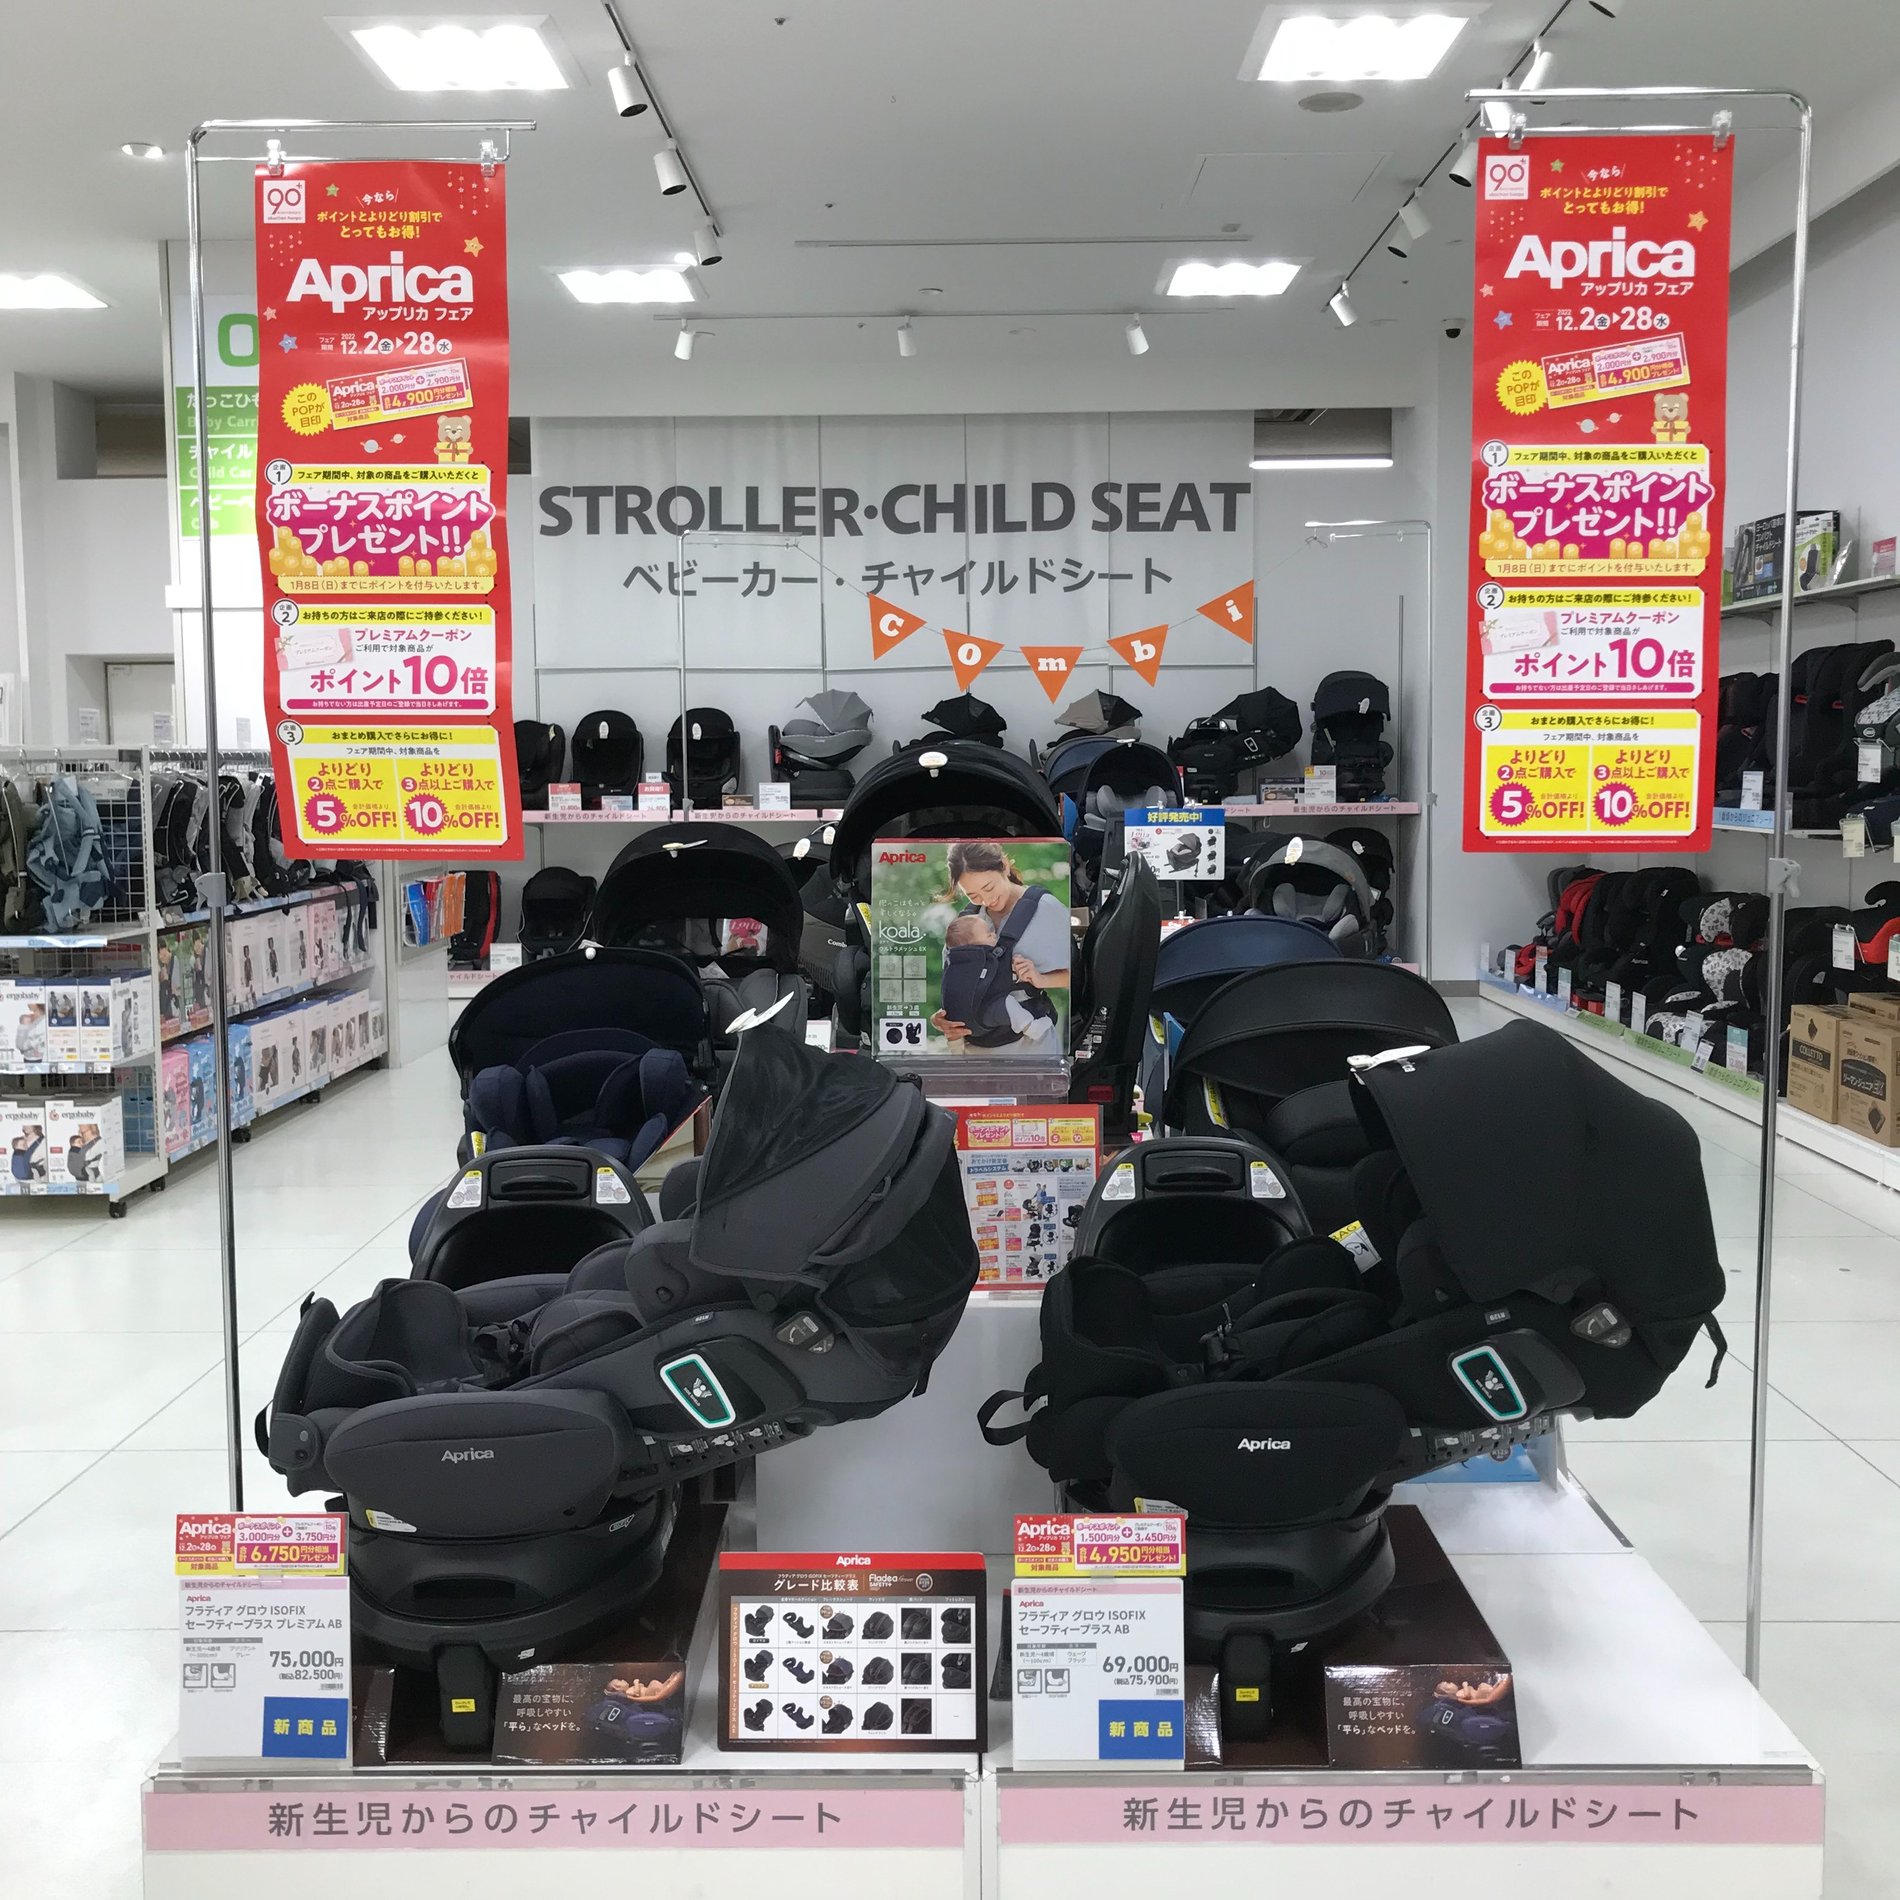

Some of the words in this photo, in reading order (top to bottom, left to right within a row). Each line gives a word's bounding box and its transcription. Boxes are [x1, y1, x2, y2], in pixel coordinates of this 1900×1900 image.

[1587, 166, 1621, 180] 今なら
[362, 191, 395, 204] 今なら
[1540, 187, 1668, 198] ポイントとよりどり割引で
[1563, 201, 1645, 214] とってもお得!
[317, 211, 442, 222] ポイントとよりどり割引で
[339, 225, 420, 239] とってもお得!
[1504, 227, 1695, 289] Aprica
[286, 251, 473, 313] Aprica
[1581, 283, 1647, 296] アップリカ
[1654, 283, 1693, 295] フェア
[362, 307, 428, 321] アップリカ
[435, 307, 473, 321] フェア
[1548, 358, 1590, 374] Aprica
[1512, 370, 1532, 381] この
[333, 382, 375, 397] Aprica
[1507, 380, 1540, 393] POPが
[297, 393, 317, 403] この
[1515, 395, 1536, 407] 目印
[292, 403, 325, 416] POPが
[301, 417, 321, 428] 目印
[1492, 453, 1497, 463] 1
[1514, 452, 1697, 460] フェア期間中、対象の商品をご購入いただくと
[276, 472, 281, 482] 1
[298, 470, 479, 480] フェア期間中、対象の商品をご購入いただくと
[1490, 474, 1708, 503] ボーナスポイント
[273, 492, 489, 521] ボーナスポイント
[1091, 482, 1251, 533] SEAT
[1513, 507, 1676, 537] プレゼント!!
[298, 524, 462, 555] プレゼント!!
[1487, 595, 1495, 606] 2
[1509, 594, 1692, 602] お持ちの方はご来店の際にご持参ください!
[282, 612, 290, 622] 2
[303, 611, 482, 620] お持ちの方はご来店の際にご持参ください!
[1561, 612, 1680, 624] プレミアムクーポン
[355, 629, 472, 641] プレミアムクーポン
[1561, 627, 1640, 635] ご利用で対象商品が
[356, 644, 433, 653] ご利用で対象商品が
[1485, 717, 1493, 728] 3
[1531, 717, 1654, 725] おまとめ購入でさらにお得に!
[288, 732, 295, 742] 3
[332, 732, 452, 740] おまとめ購入でさらにお得に!
[1543, 733, 1638, 741] フェア期間中、対象商品を
[1510, 750, 1565, 764] よりどり
[1616, 750, 1670, 764] よりどり
[318, 763, 371, 776] よりどり
[420, 763, 473, 776] よりどり
[1148, 812, 1202, 822] 好評発売中!
[879, 850, 926, 865] Aprica
[879, 920, 922, 940] koala
[7, 991, 39, 1001] ergobaby
[5, 1111, 40, 1121] ergobaby
[62, 1110, 96, 1120] ergobaby
[1238, 1437, 1291, 1452] Aprica
[441, 1447, 494, 1464] Aprica
[180, 1520, 231, 1536] Aprica
[238, 1522, 281, 1530] ボーナスポイント
[1018, 1521, 1069, 1537] Aprica
[239, 1533, 280, 1541] 3,000円分
[296, 1533, 336, 1541] 3,750円分
[1081, 1533, 1120, 1542] 1,500円分
[1135, 1533, 1176, 1542] 3,450円分
[251, 1546, 299, 1562] 6,750
[1090, 1547, 1140, 1562] 4,950
[836, 1555, 871, 1567] Aprica
[774, 1580, 859, 1591] グレード比較表
[185, 1606, 233, 1615] フラディア
[237, 1605, 265, 1615] グロウ
[271, 1606, 306, 1615] ISOFIX
[1019, 1611, 1068, 1621] フラディア
[1072, 1611, 1105, 1621] グロウ
[1108, 1611, 1146, 1620] ISOFIX
[185, 1619, 273, 1630] セーフティープラス
[277, 1619, 325, 1629] プレミアム
[328, 1620, 342, 1628] AB
[1019, 1625, 1111, 1635] セーフティープラス
[1114, 1625, 1129, 1634] AB
[270, 1651, 344, 1668] 75,000円
[1103, 1657, 1178, 1673] 69,000円
[513, 1694, 574, 1704] 最高の宝物に、
[1343, 1697, 1405, 1707] 最高の宝物に、
[517, 1707, 571, 1717] 呼吸しやすい
[1349, 1710, 1404, 1721] 呼吸しやすい
[504, 1721, 581, 1731] 「平ら」なベッドを。
[1337, 1725, 1416, 1736] 「平ら」なベッドを。
[268, 1802, 842, 1836] 新生児からのチャイルドシート
[1123, 1797, 1700, 1831] 新生児からのチャイルドシート
